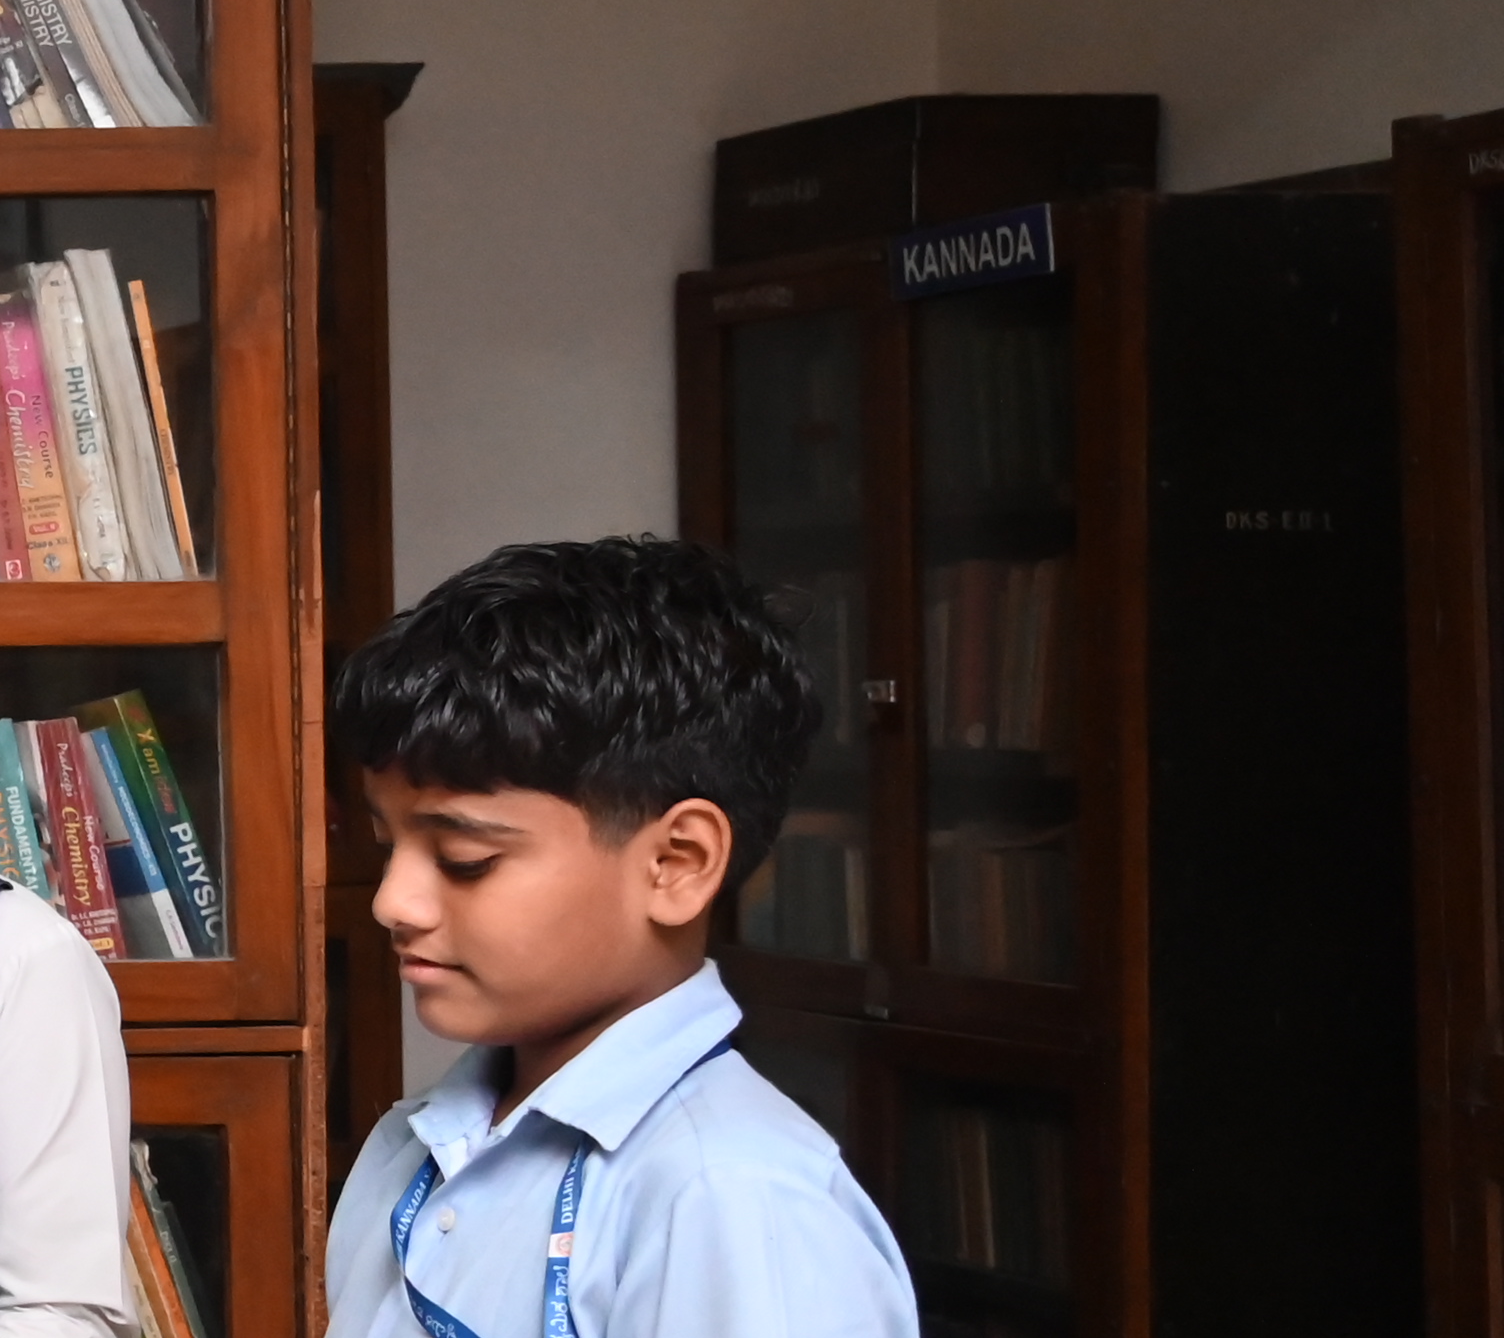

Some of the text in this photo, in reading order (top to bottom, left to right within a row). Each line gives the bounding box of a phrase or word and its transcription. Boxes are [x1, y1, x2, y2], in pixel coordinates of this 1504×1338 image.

[902, 222, 1037, 286] KANNADA
[4, 388, 35, 489] Chemistry
[30, 394, 56, 479] New Course
[65, 366, 98, 457] PHYSICS
[61, 806, 92, 906] Chemistry
[82, 815, 105, 892] New Course
[395, 1180, 428, 1241] KANNADA
[561, 1178, 576, 1225] DELHI
